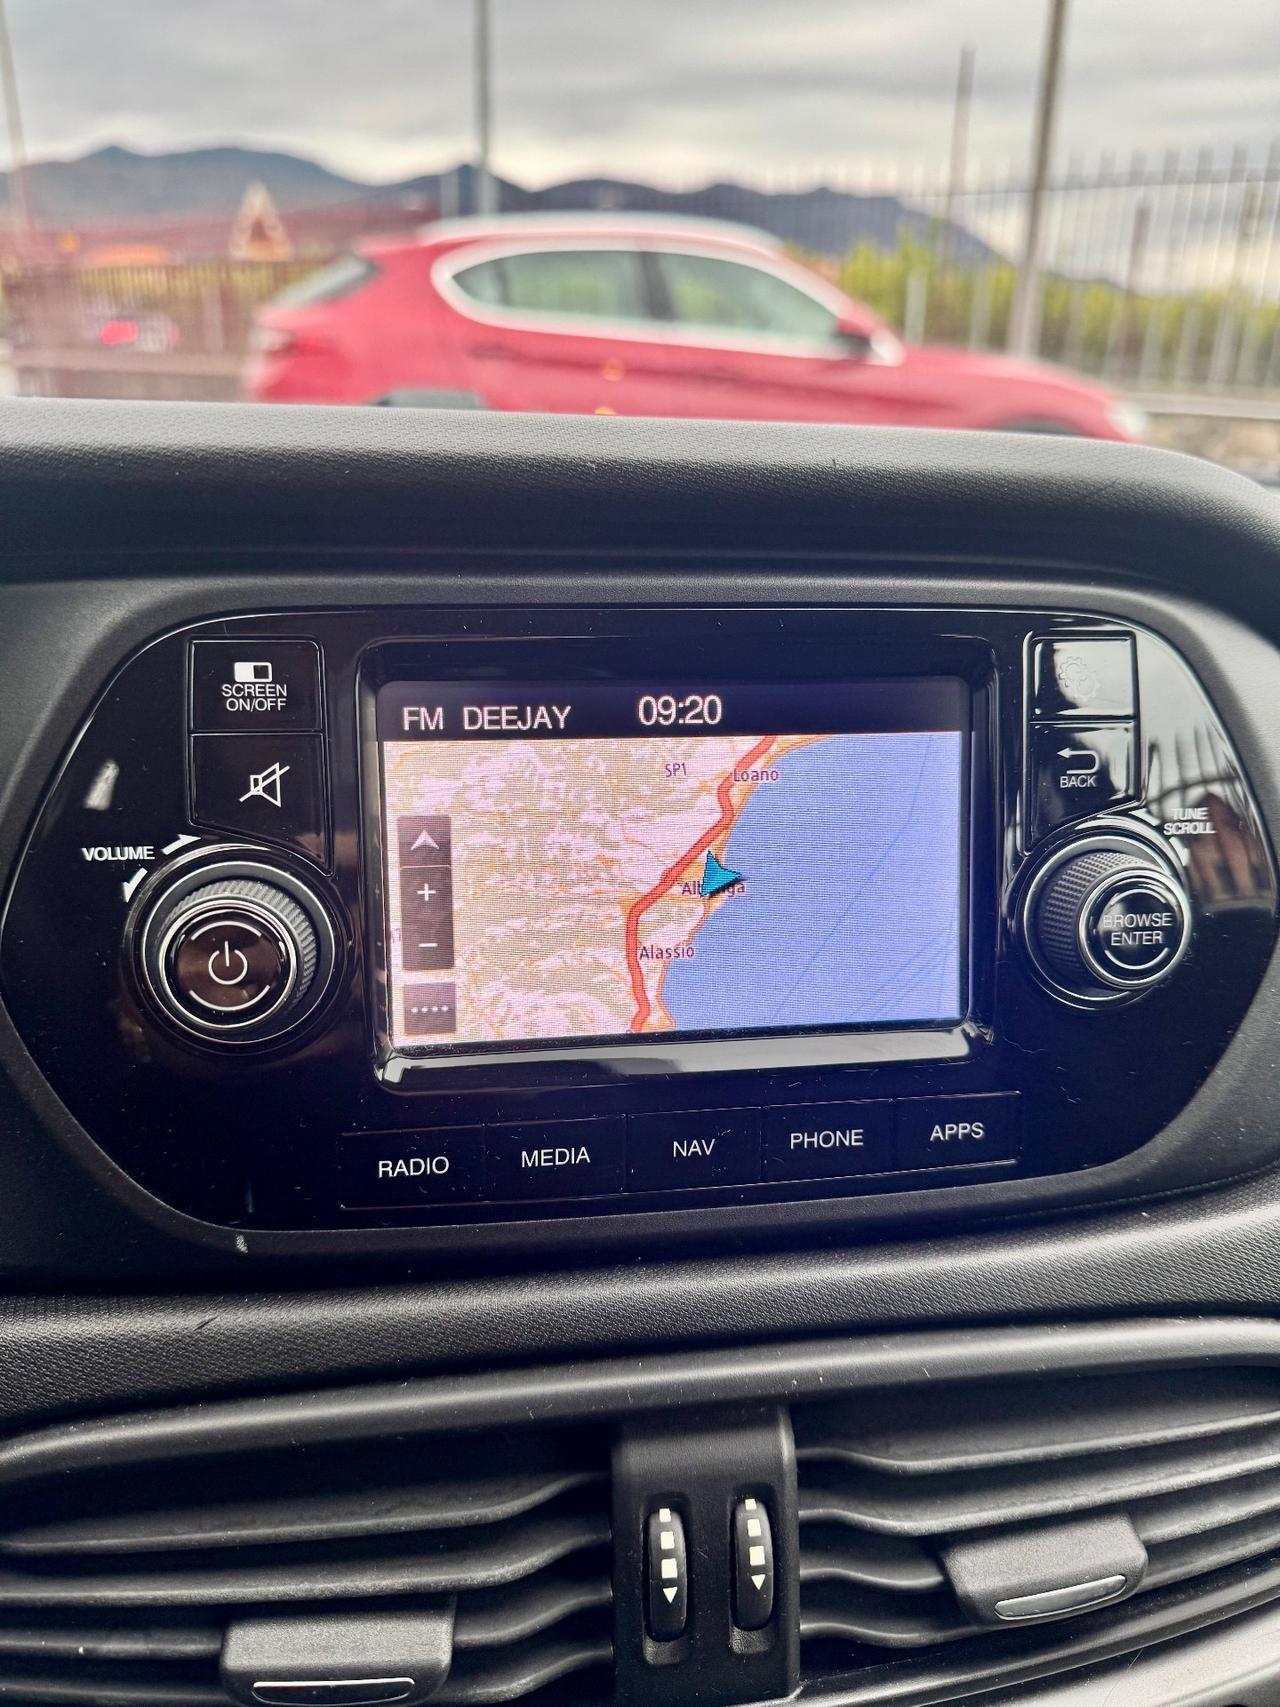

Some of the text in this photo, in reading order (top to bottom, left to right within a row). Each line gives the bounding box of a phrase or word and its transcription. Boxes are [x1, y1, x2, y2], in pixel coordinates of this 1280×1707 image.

[221, 683, 287, 697] SCREEN
[225, 698, 287, 712] ON/OFF
[638, 695, 722, 725] 09:20
[402, 705, 572, 731] FM DEEJAY
[665, 762, 687, 778] SP1
[733, 767, 779, 782] Loano
[1059, 774, 1097, 789] BACK
[1172, 807, 1209, 821] TUNE
[1163, 821, 1216, 836] SCROLL
[81, 845, 155, 862] VOLUME
[681, 880, 746, 898] Alga
[1102, 912, 1173, 929] BROWSE
[1110, 930, 1163, 946] ENTER
[639, 944, 695, 960] Alassio
[789, 1129, 865, 1150] PHONE
[929, 1121, 986, 1142] APPS
[672, 1138, 716, 1158] NAV
[520, 1145, 591, 1169] MEDIA
[377, 1155, 451, 1179] RADIO
